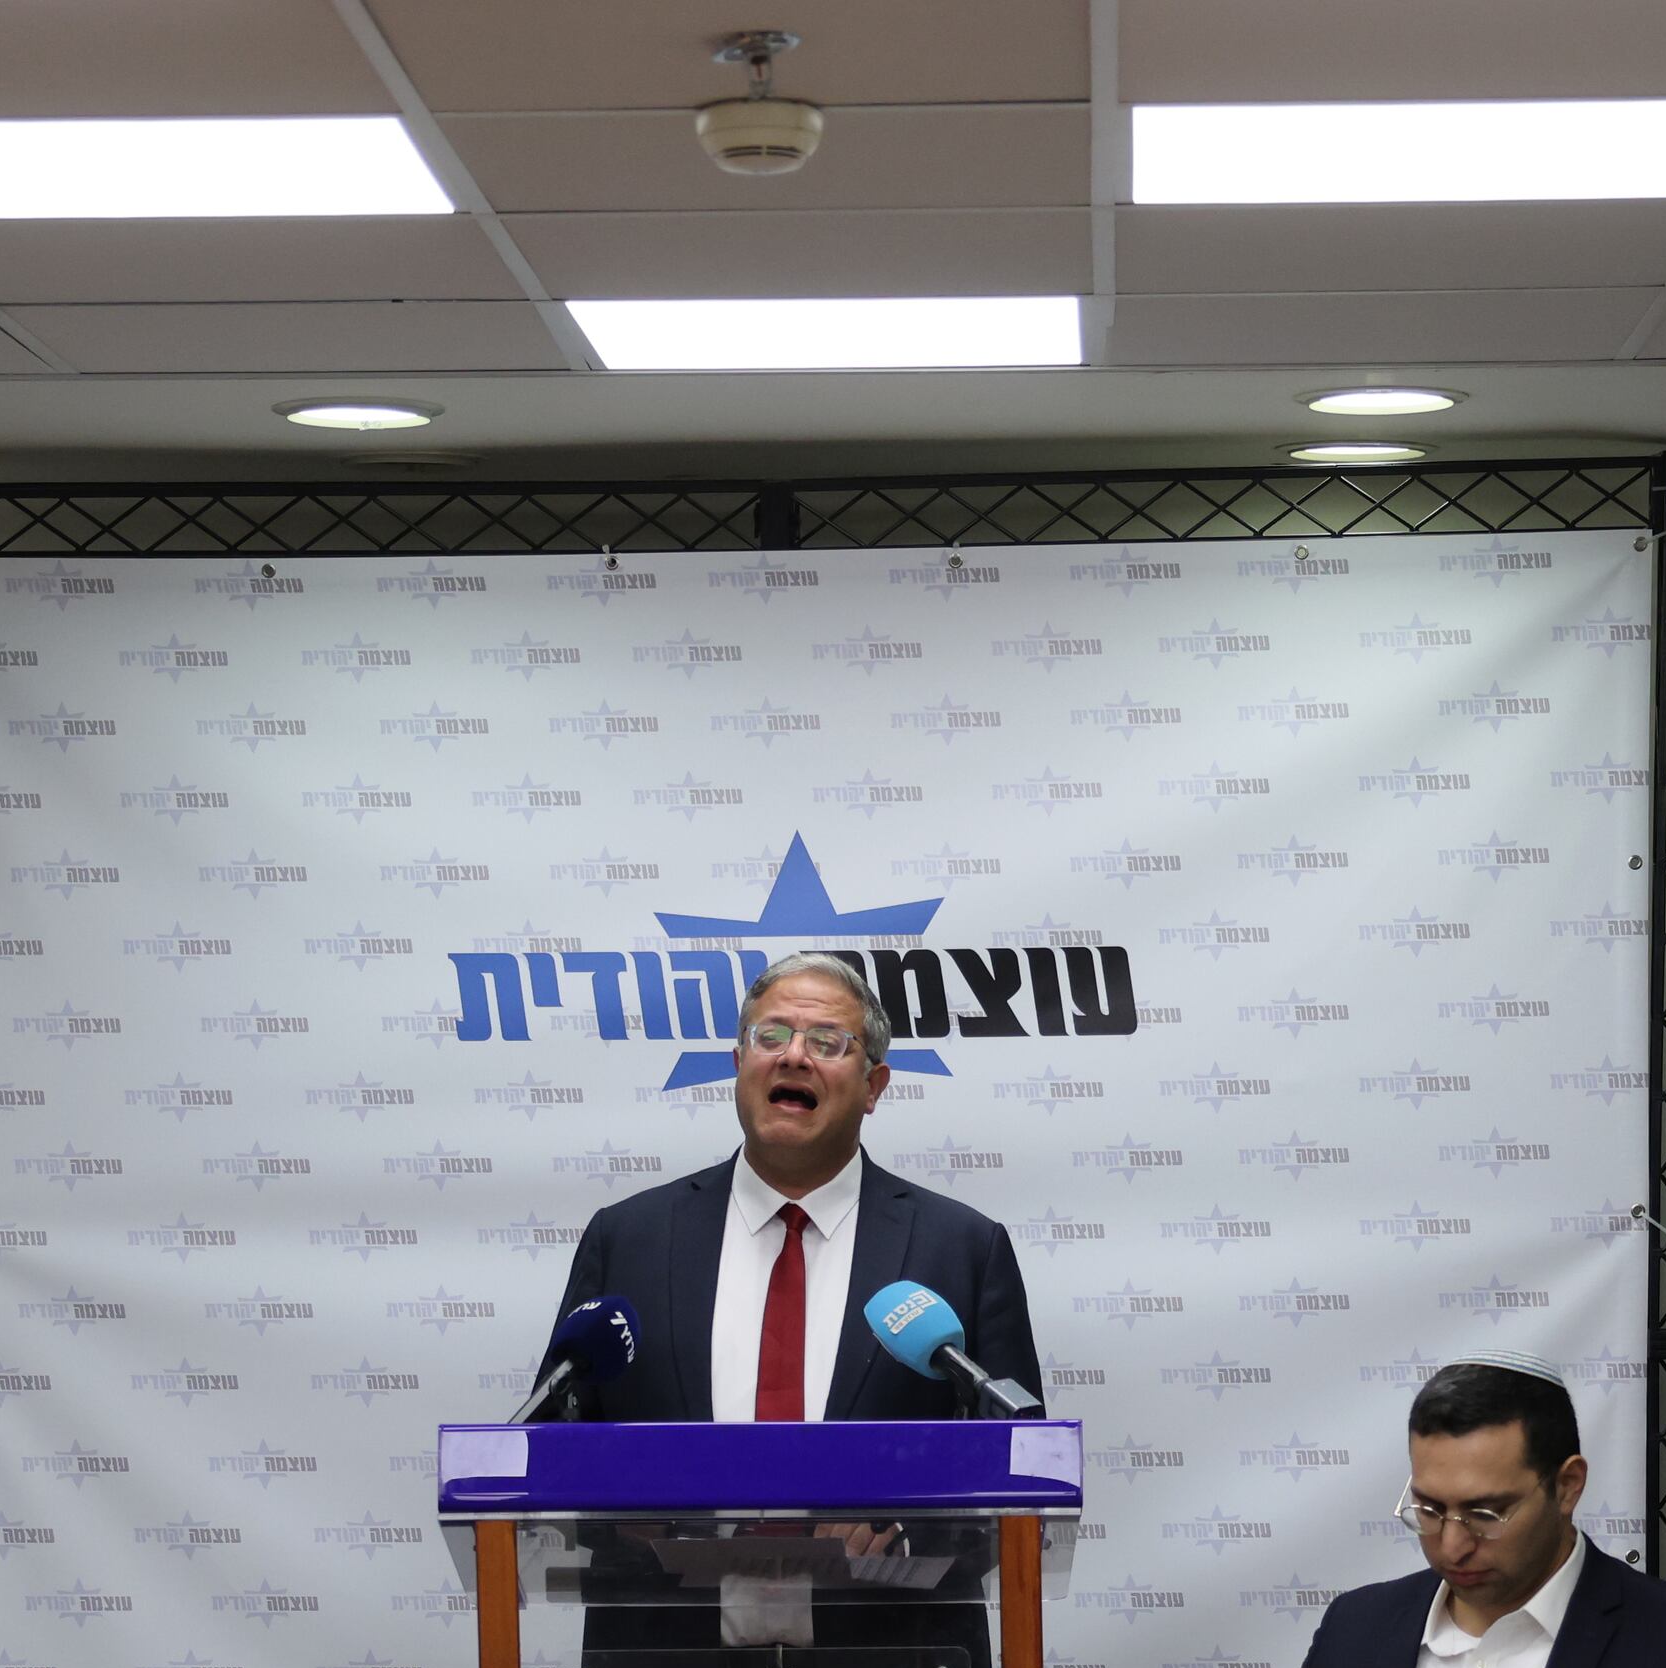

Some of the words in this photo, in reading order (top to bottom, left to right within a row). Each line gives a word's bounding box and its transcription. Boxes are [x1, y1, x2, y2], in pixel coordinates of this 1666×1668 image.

[1293, 558, 1349, 575] עוצמה
[1496, 552, 1552, 570] עוצמה
[764, 570, 819, 587] עוצמה
[944, 566, 1000, 584] עוצמה
[1125, 563, 1181, 580] עוצמה
[60, 578, 115, 594] עוצמה
[249, 577, 304, 594] עוצמה
[431, 576, 487, 592] עוצמה
[601, 573, 657, 590] עוצמה
[1215, 635, 1271, 652] עוצמה
[1416, 629, 1472, 646] עוצמה
[526, 647, 581, 664] עוצמה
[688, 645, 743, 662] עוצמה
[868, 642, 923, 659] עוצמה
[1048, 639, 1103, 656] עוצמה
[174, 650, 229, 667] עוצמה
[357, 649, 411, 666] עוצמה
[1294, 703, 1350, 720] עוצמה
[1495, 697, 1551, 715] עוצמה
[604, 716, 659, 733] עוצמה
[766, 714, 821, 731] עוצמה
[947, 711, 1002, 728] עוצמה
[1126, 707, 1182, 725] עוצמה
[62, 719, 117, 736] עוצמה
[252, 719, 307, 736] עוצמה
[435, 718, 489, 735] עוצמה
[1048, 782, 1103, 799] עוצמה
[1215, 778, 1270, 795] עוצמה
[1415, 774, 1471, 791] עוצמה
[175, 792, 229, 809] עוצמה
[358, 791, 412, 808] עוצמה
[528, 790, 582, 807] עוצמה
[689, 788, 743, 805] עוצמה
[868, 786, 923, 802] עוצמה
[1126, 855, 1182, 872] עוצמה
[1293, 852, 1349, 869] עוצמה
[1495, 847, 1550, 865] עוצמה
[66, 867, 120, 883] עוצמה
[254, 866, 308, 883] עוצמה
[436, 865, 490, 881] עוצמה
[605, 863, 660, 880] עוצמה
[947, 858, 1001, 875] עוצמה
[1048, 929, 1103, 946] עוצמה
[1215, 927, 1270, 944] עוצמה
[1415, 923, 1471, 940] עוצמה
[178, 939, 232, 956] עוצמה
[359, 938, 414, 955] עוצמה
[528, 936, 582, 953] עוצמה
[1294, 1004, 1350, 1021] עוצמה
[1494, 1001, 1550, 1018] עוצמה
[68, 1017, 122, 1034] עוצמה
[255, 1017, 310, 1033] עוצמה
[1049, 1081, 1104, 1098] עוצמה
[1216, 1079, 1271, 1096] עוצמה
[1415, 1075, 1471, 1092] עוצמה
[179, 1089, 233, 1106] עוצמה
[361, 1088, 415, 1105] עוצמה
[530, 1087, 584, 1104] עוצמה
[949, 1152, 1004, 1169] עוצמה
[1128, 1150, 1183, 1167] עוצמה
[1295, 1147, 1350, 1164] עוצמה
[1495, 1144, 1551, 1161] עוצמה
[69, 1158, 123, 1175] עוצמה
[257, 1158, 311, 1175] עוצמה
[438, 1157, 493, 1174] עוצמה
[608, 1156, 662, 1173] עוצמה
[1051, 1223, 1106, 1240] עוצמה
[1216, 1221, 1272, 1238] עוצמה
[1416, 1218, 1471, 1235] עוצמה
[182, 1230, 237, 1246] עוצמה
[364, 1229, 418, 1245] עוצמה
[1129, 1296, 1184, 1313] עוצמה
[1295, 1294, 1350, 1311] עוצמה
[1495, 1291, 1550, 1308] עוצמה
[72, 1303, 127, 1319] עוצמה
[260, 1303, 314, 1319] עוצמה
[441, 1302, 495, 1318] עוצמה
[185, 1374, 239, 1391] עוצמה
[365, 1374, 420, 1390] עוצמה
[1051, 1369, 1106, 1386] עוצמה
[1216, 1367, 1272, 1384] עוצמה
[76, 1456, 130, 1473] עוצמה
[264, 1456, 318, 1472] עוצמה
[1130, 1451, 1184, 1467] עוצמה
[1295, 1449, 1350, 1466] עוצמה
[2, 1528, 55, 1544] עוצמה
[188, 1528, 242, 1544] עוצמה
[369, 1527, 423, 1543] עוצמה
[1217, 1522, 1272, 1539] עוצמה
[79, 1595, 133, 1612] עוצמה
[266, 1595, 319, 1612] עוצמה
[1130, 1592, 1185, 1608] עוצמה
